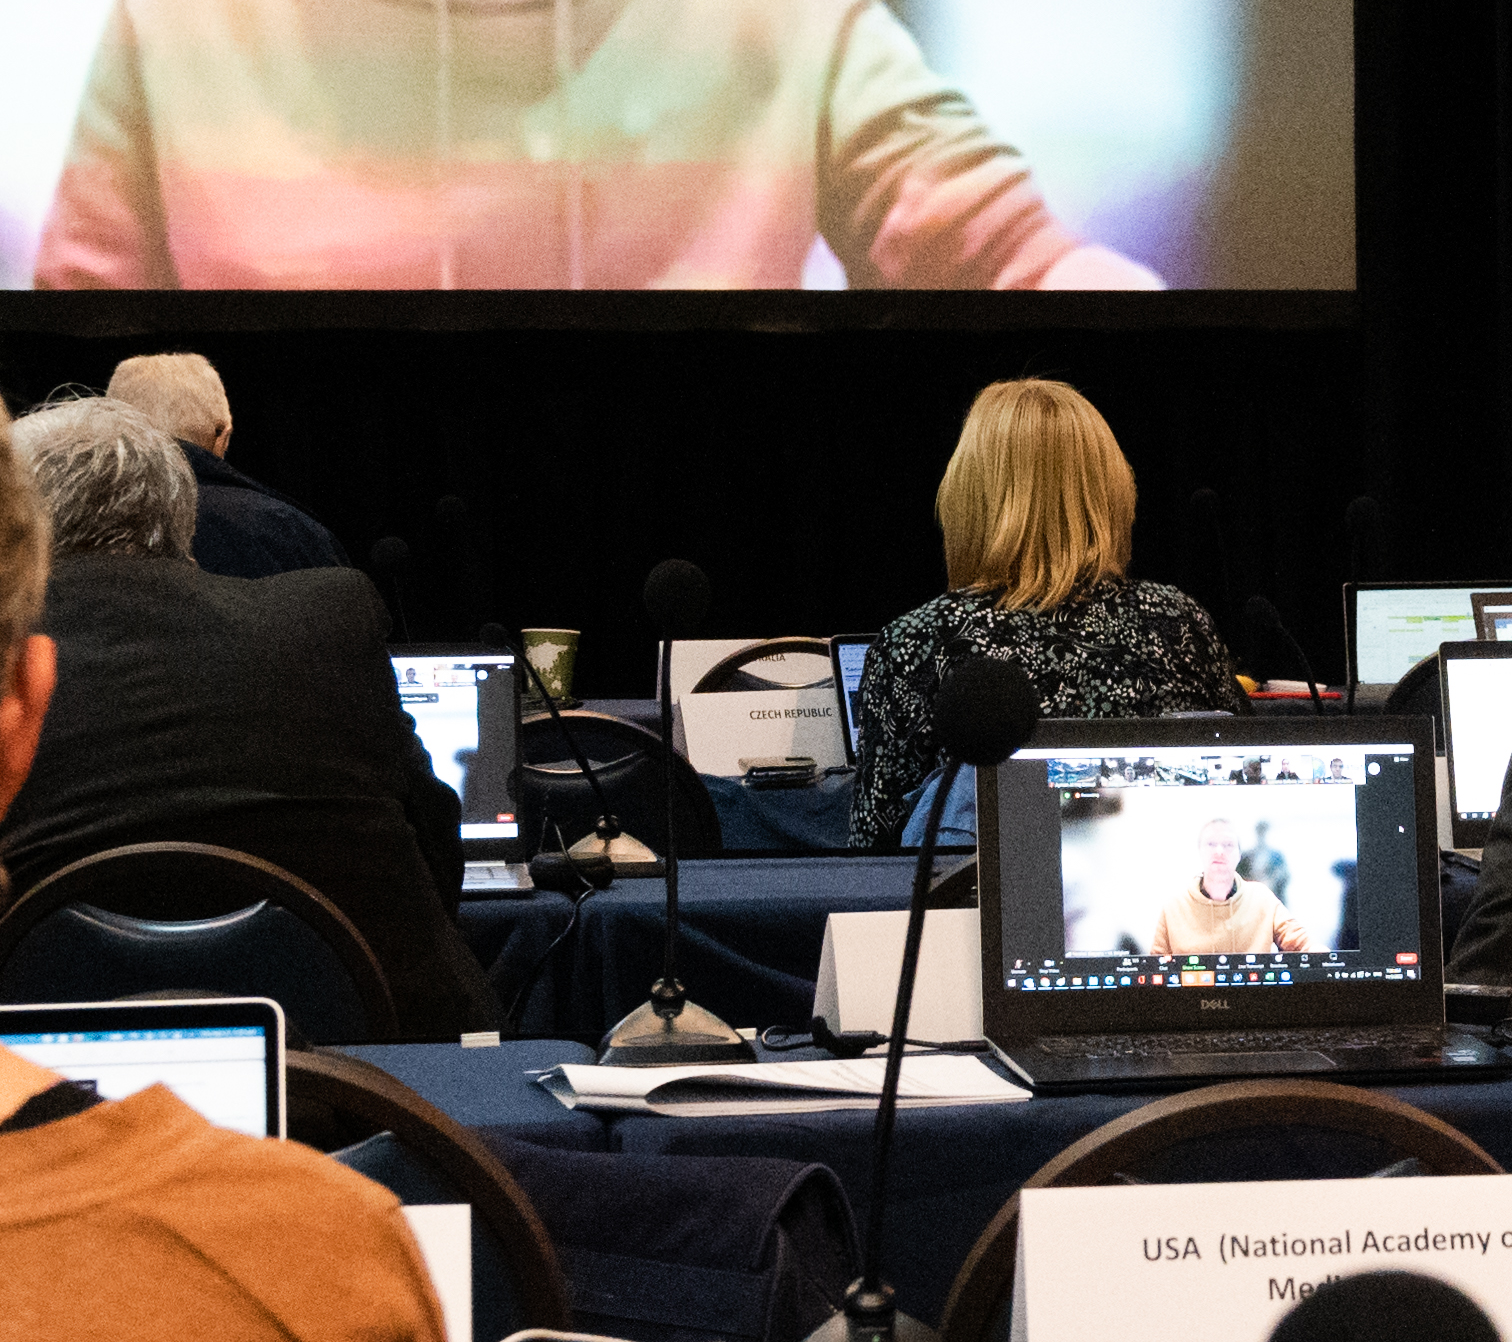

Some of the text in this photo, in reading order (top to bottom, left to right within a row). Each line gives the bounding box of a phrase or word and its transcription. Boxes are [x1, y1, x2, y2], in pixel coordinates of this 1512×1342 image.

[749, 707, 833, 720] CZECH REPUBLIC
[1200, 999, 1231, 1011] DELL
[1143, 1236, 1202, 1262] USA
[1219, 1229, 1351, 1265] (National
[1361, 1226, 1492, 1256] Academy
